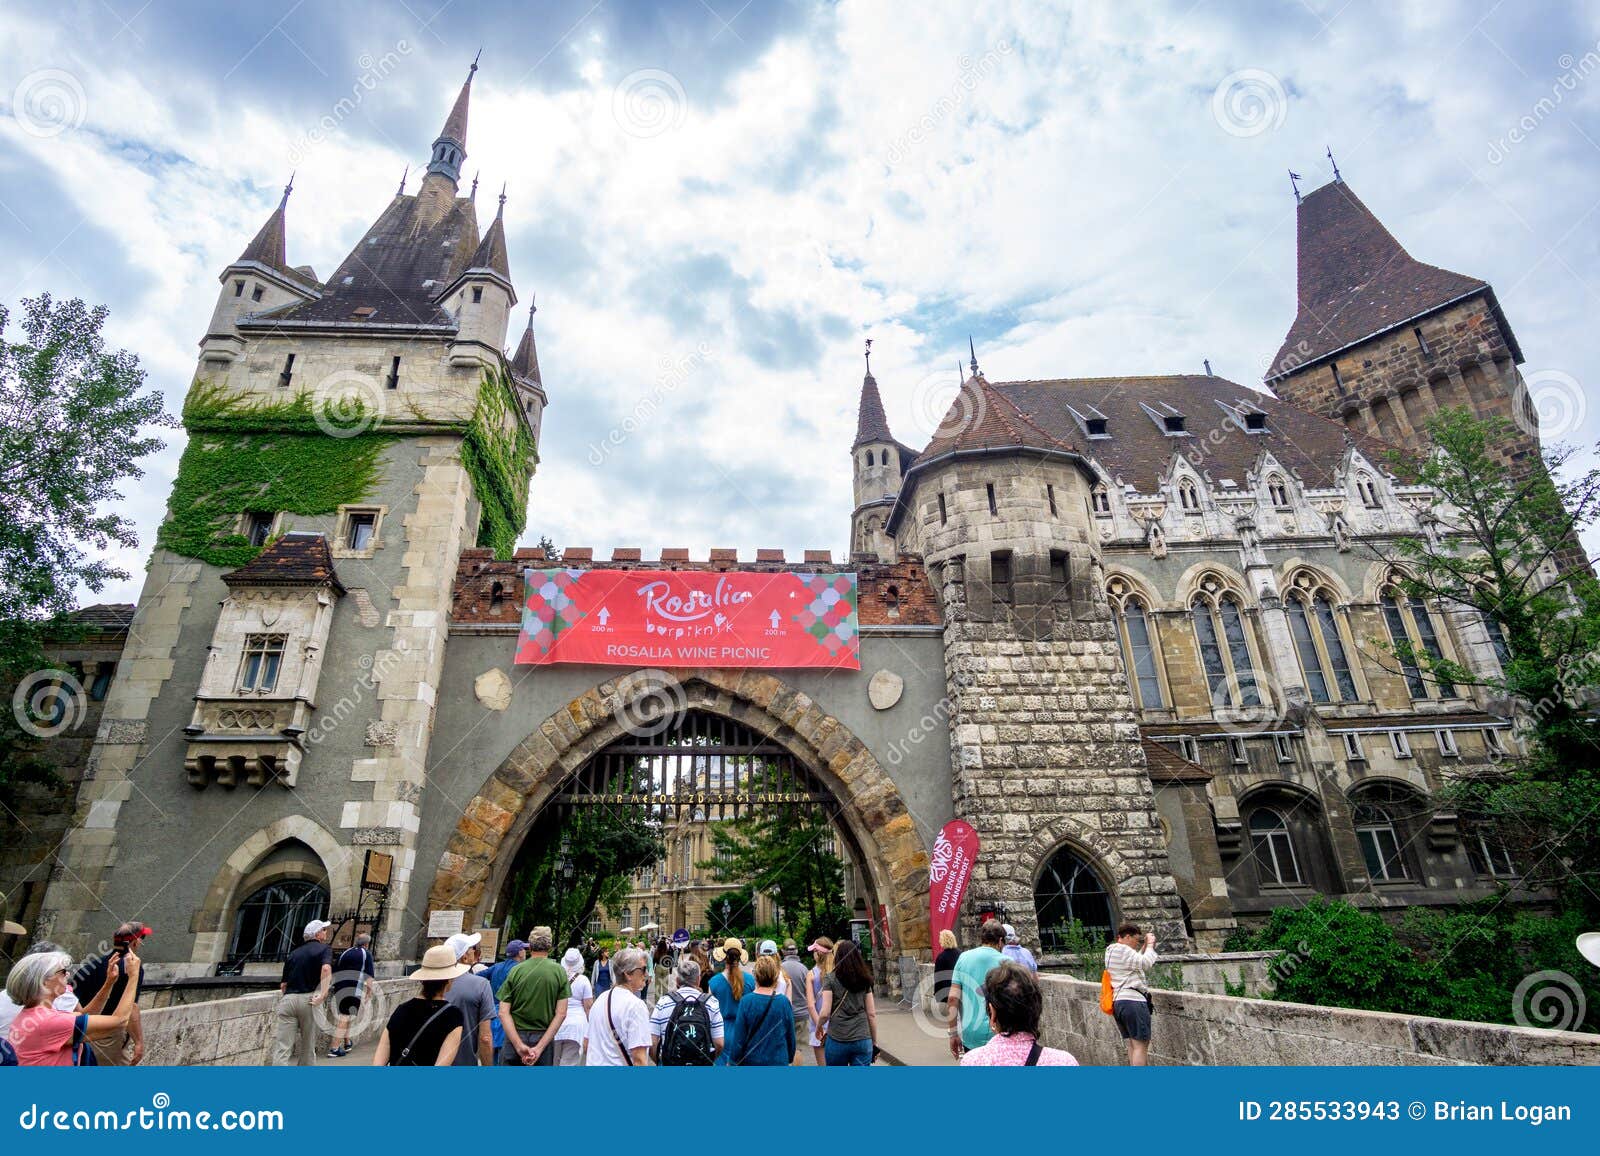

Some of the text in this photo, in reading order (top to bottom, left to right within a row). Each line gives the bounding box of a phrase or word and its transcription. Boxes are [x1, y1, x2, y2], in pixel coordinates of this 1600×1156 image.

[637, 576, 752, 621] Rosalia
[592, 625, 606, 633] 200
[607, 645, 770, 659] ROSALIA WINE PICNIC
[570, 793, 623, 804] MAGYAR
[939, 870, 957, 913] SOUVENIR
[952, 846, 964, 870] SHOP
